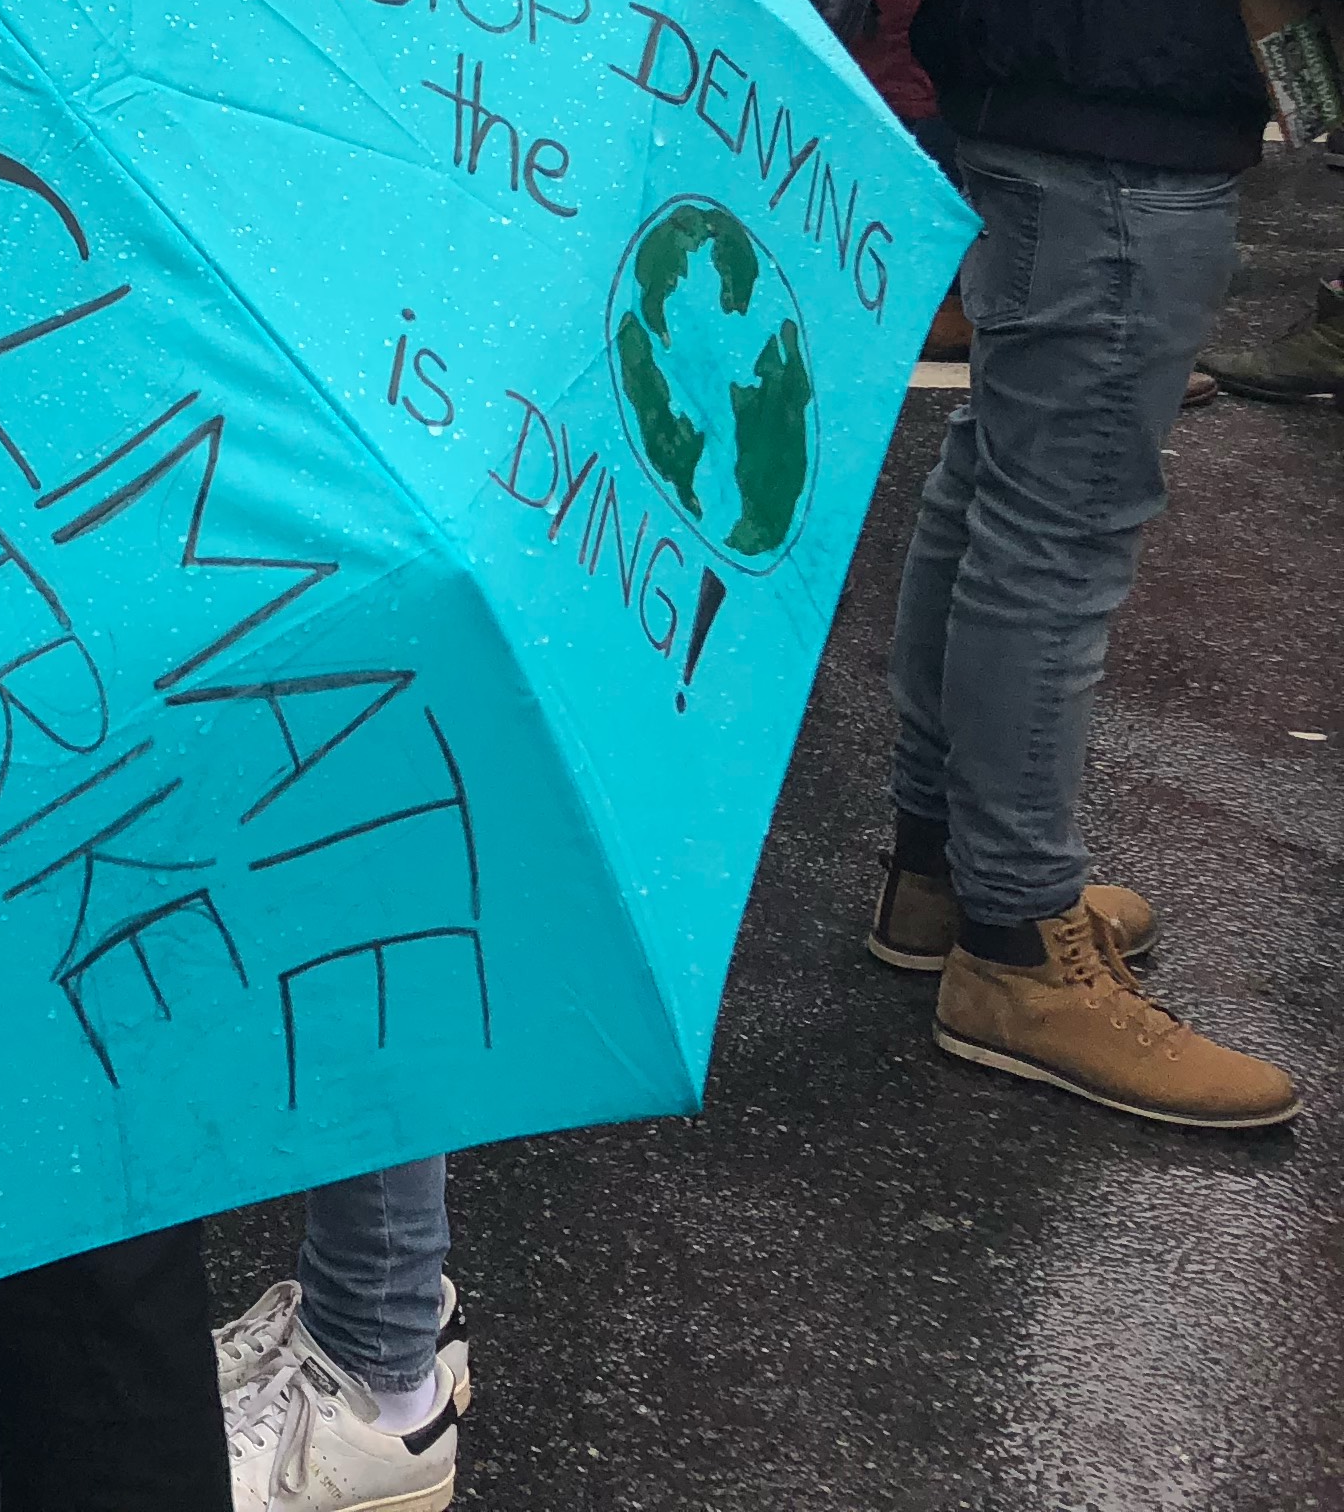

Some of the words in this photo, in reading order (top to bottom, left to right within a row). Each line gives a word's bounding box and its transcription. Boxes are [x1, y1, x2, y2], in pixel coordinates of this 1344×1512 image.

[420, 52, 579, 217] the
[608, 1, 894, 325] DENYING
[386, 308, 455, 429] is
